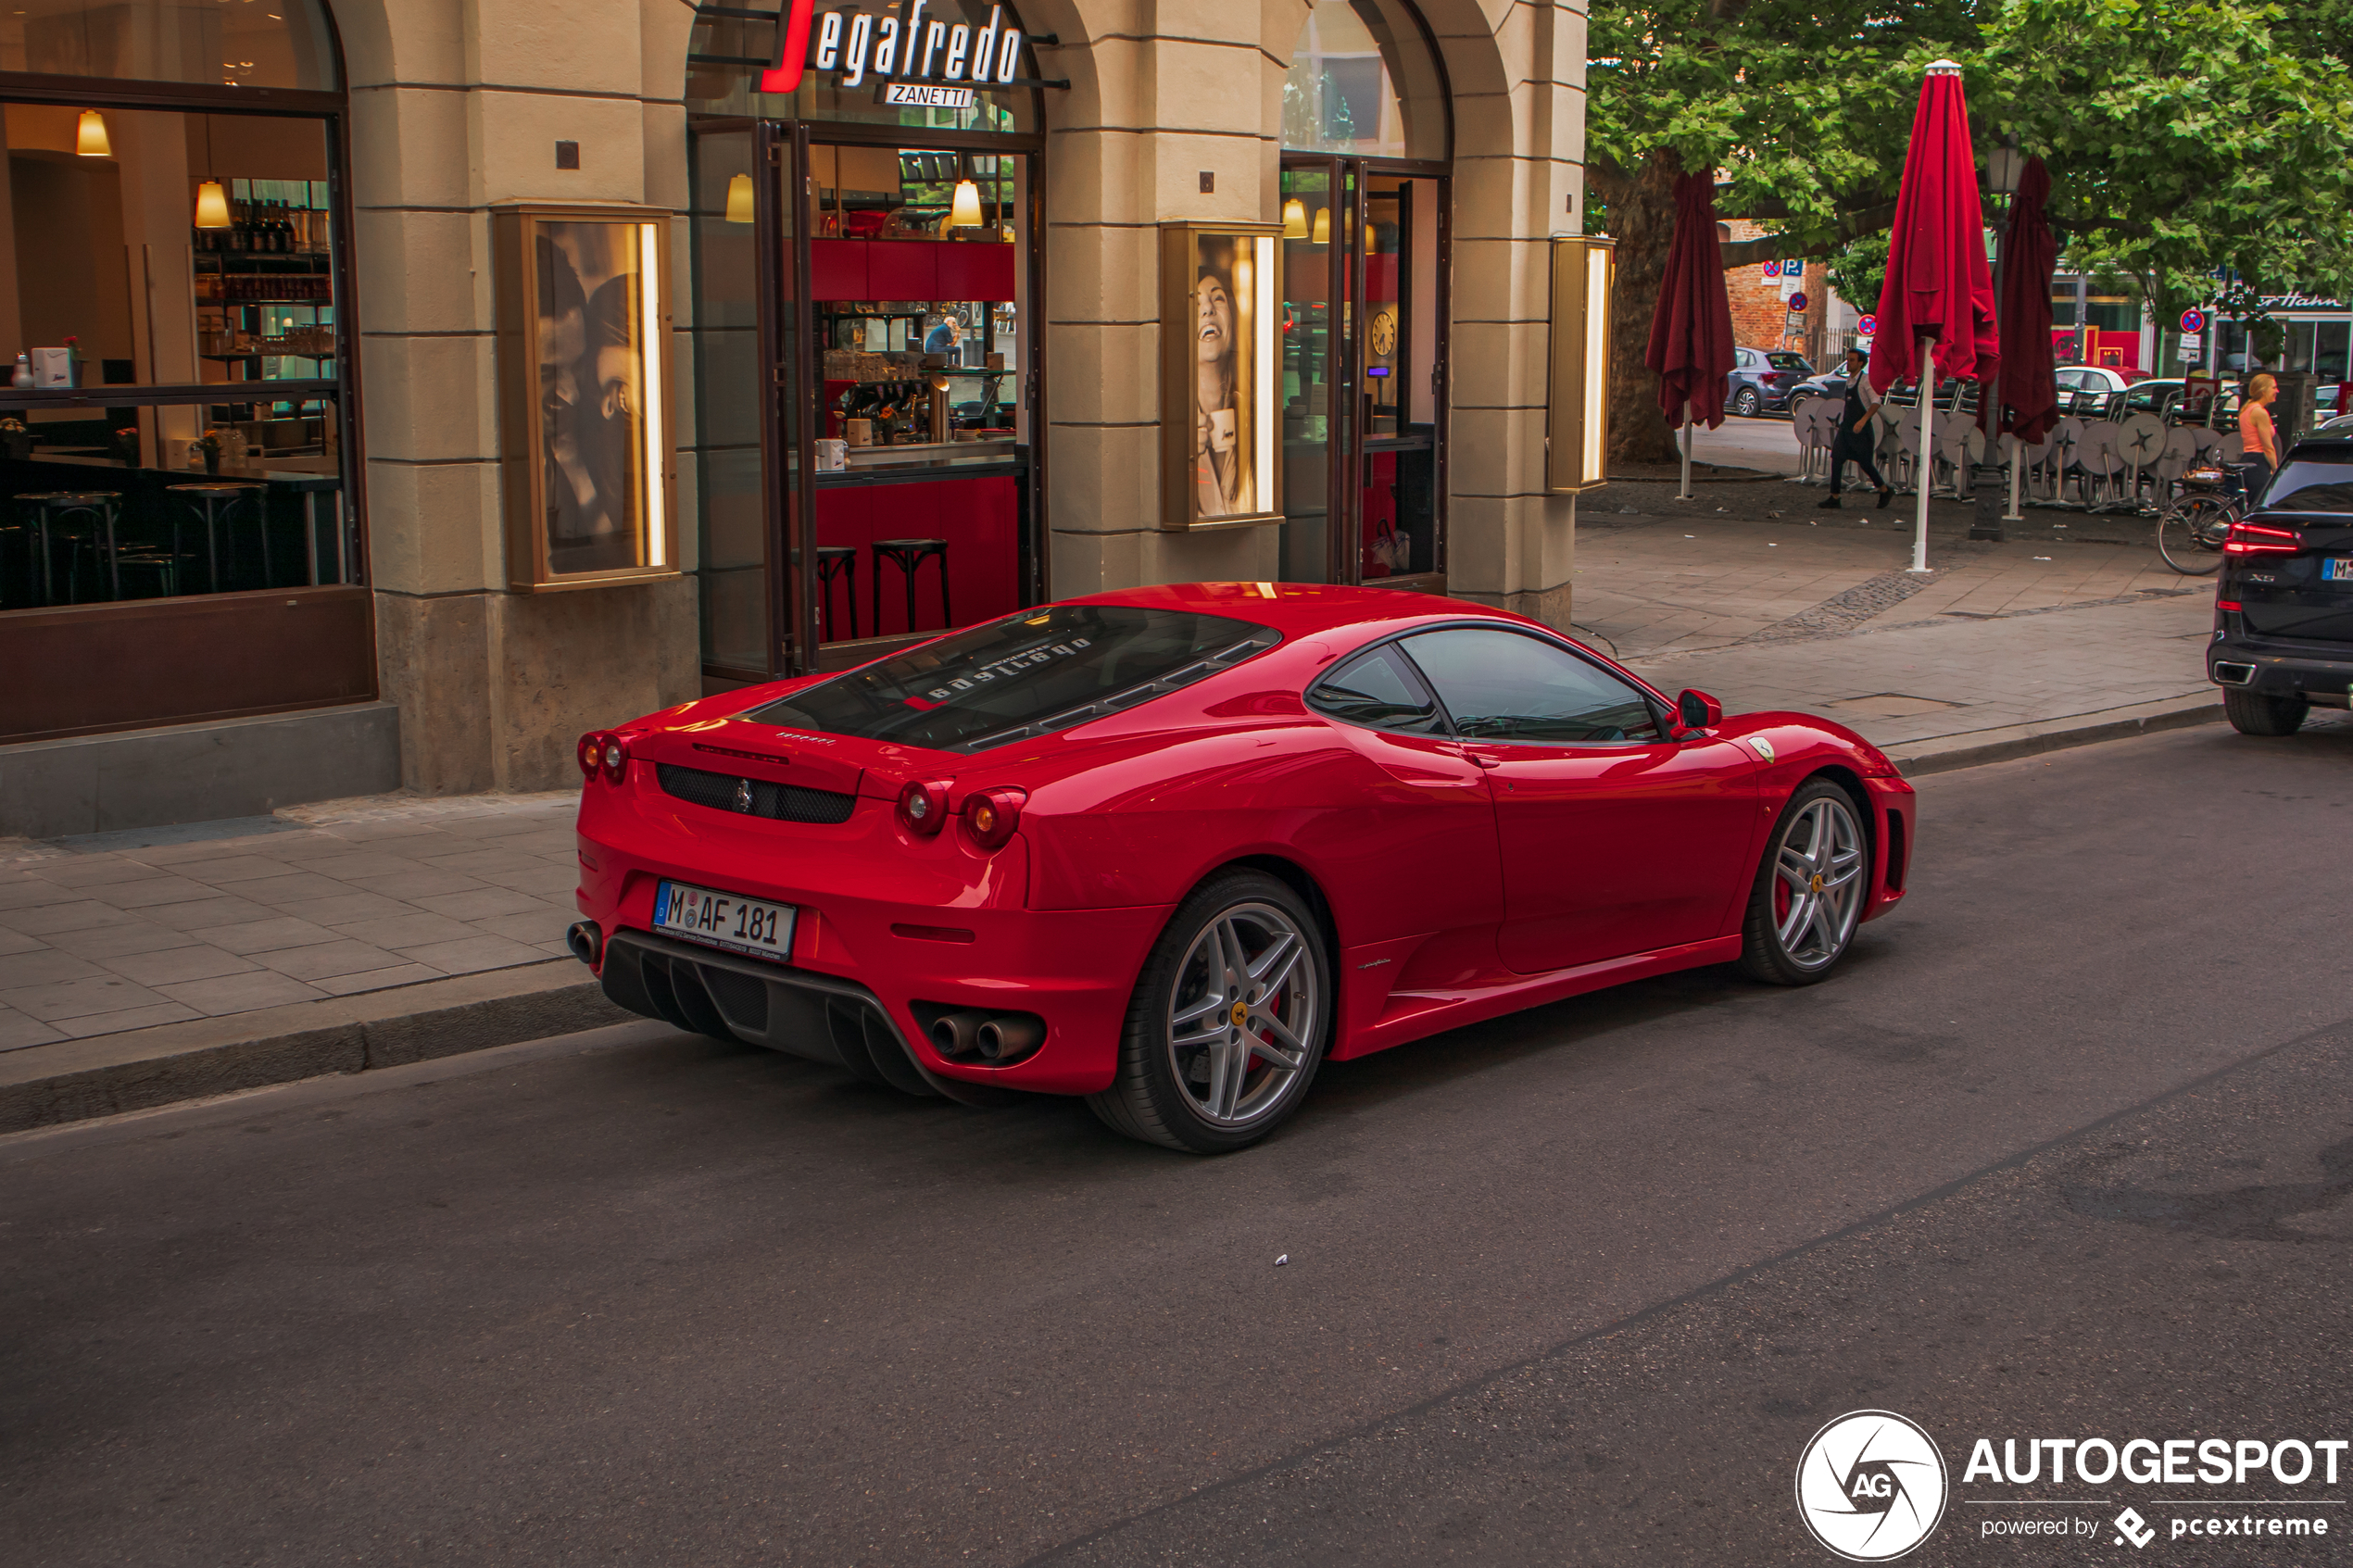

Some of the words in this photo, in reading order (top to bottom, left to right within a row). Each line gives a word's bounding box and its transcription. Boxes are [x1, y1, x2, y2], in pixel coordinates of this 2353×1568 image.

[892, 85, 967, 107] ZANETTI
[1785, 259, 1798, 274] P
[2278, 291, 2343, 307] Hahn
[2334, 560, 2347, 578] M
[2249, 573, 2275, 583] X5
[659, 908, 664, 917] D
[667, 889, 685, 923] M
[698, 896, 730, 933] AF
[733, 904, 777, 945] 181
